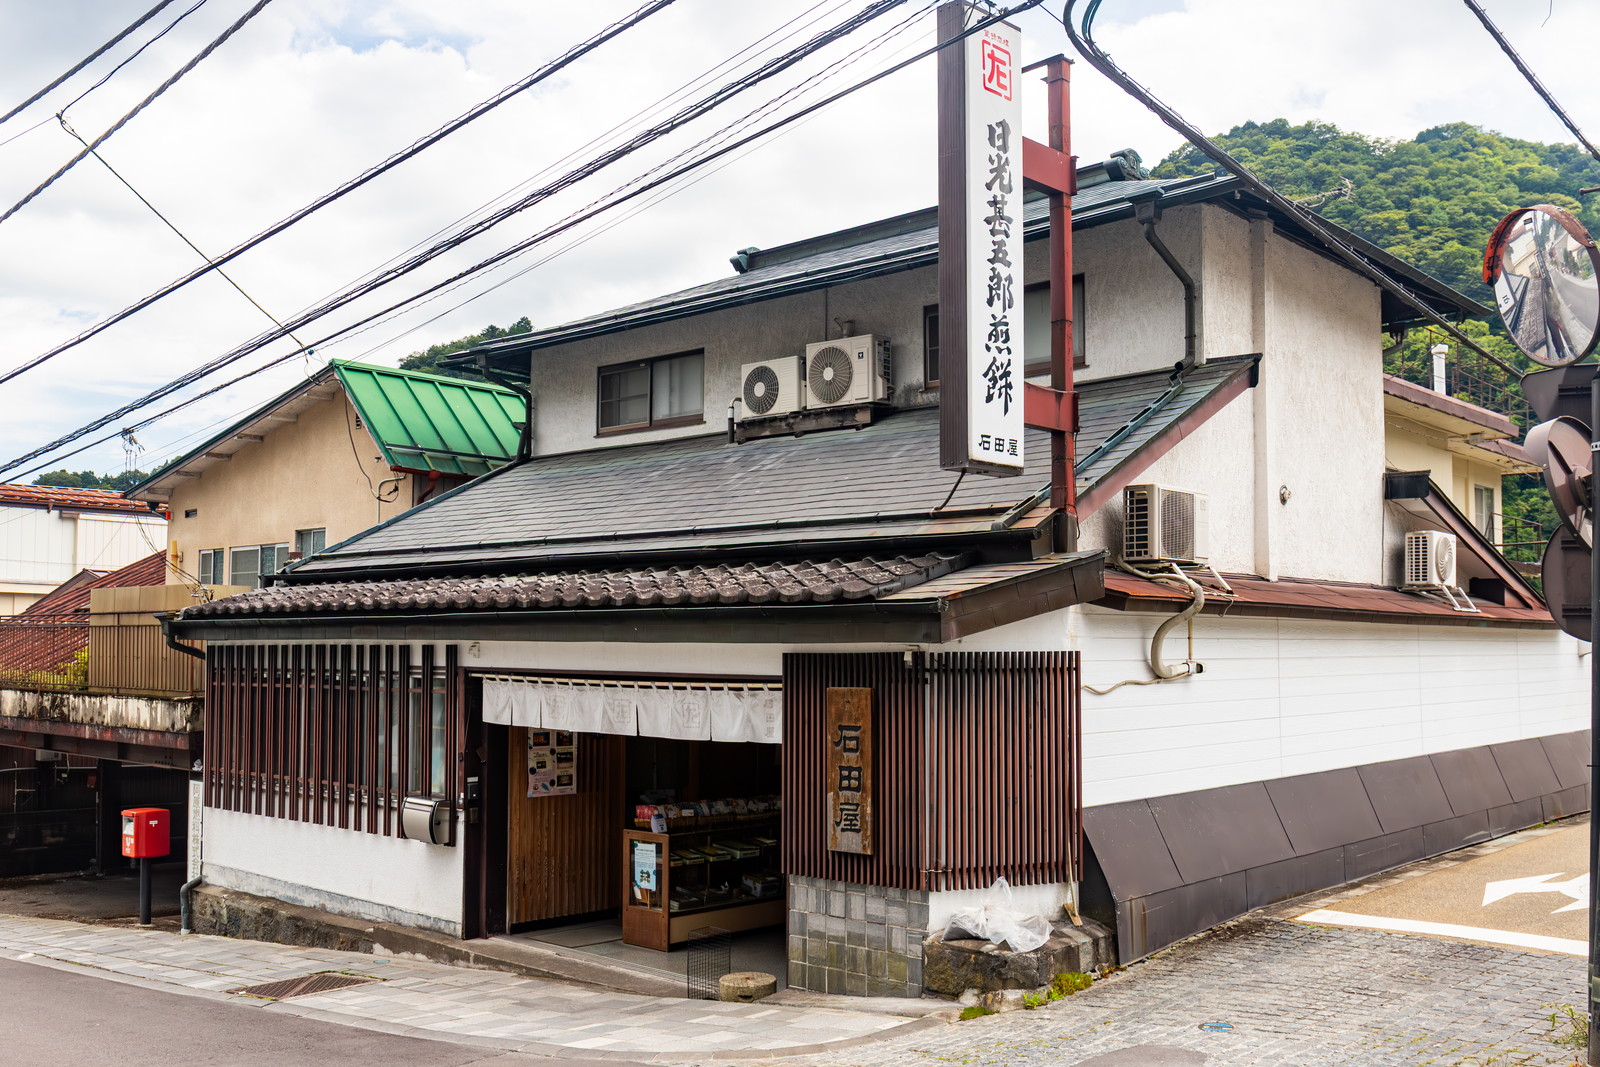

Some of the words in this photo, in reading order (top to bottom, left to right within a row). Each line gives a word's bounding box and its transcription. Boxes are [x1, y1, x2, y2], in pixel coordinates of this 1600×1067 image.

[982, 118, 1014, 417] 日光甚五郎煎餅
[979, 433, 1019, 457] 石田屋
[833, 724, 862, 834] 石田屋
